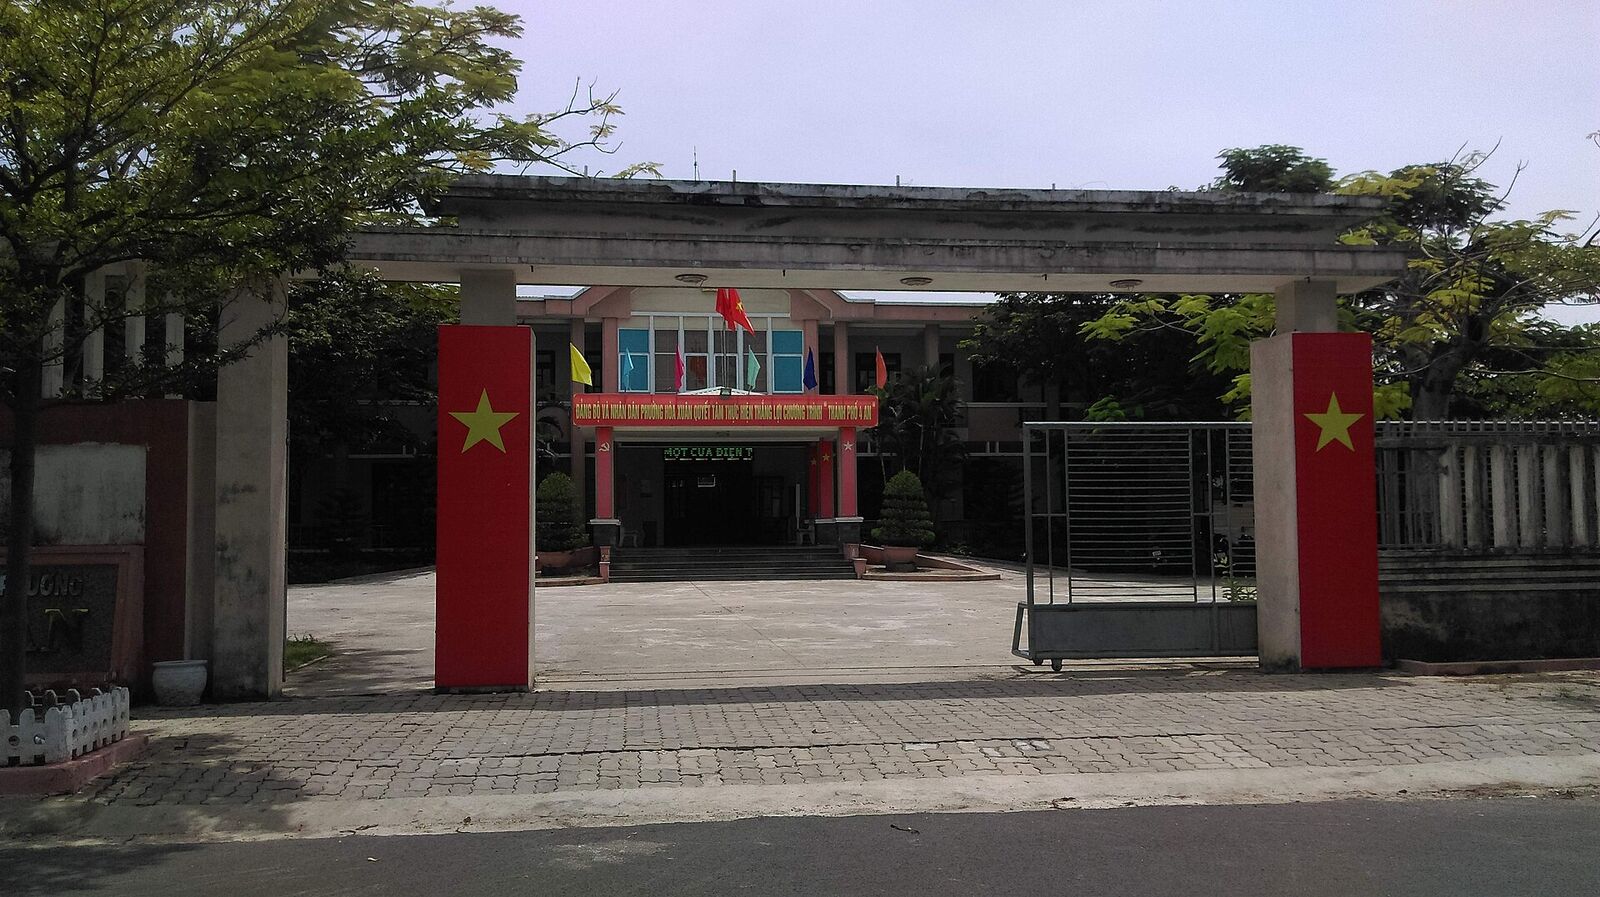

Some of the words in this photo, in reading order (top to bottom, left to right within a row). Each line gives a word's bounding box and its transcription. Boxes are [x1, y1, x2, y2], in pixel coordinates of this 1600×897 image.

[593, 401, 600, 423] BỘ
[602, 401, 609, 419] VÀ
[611, 401, 626, 419] NHÂN
[628, 401, 639, 419] DÂN
[641, 400, 663, 419] PHƯỜNG
[665, 401, 675, 419] HÒA
[677, 401, 692, 420] XUÂN
[694, 400, 710, 421] QUYẾT
[725, 403, 739, 423] THỰC
[740, 402, 753, 423] HIỆN
[755, 399, 772, 420] THẮNG
[773, 403, 782, 423] LỢI
[783, 403, 805, 420] CHƯƠNG
[806, 402, 822, 420] TRÌNH
[847, 400, 858, 420] PHỐ
[859, 405, 862, 420] 4
